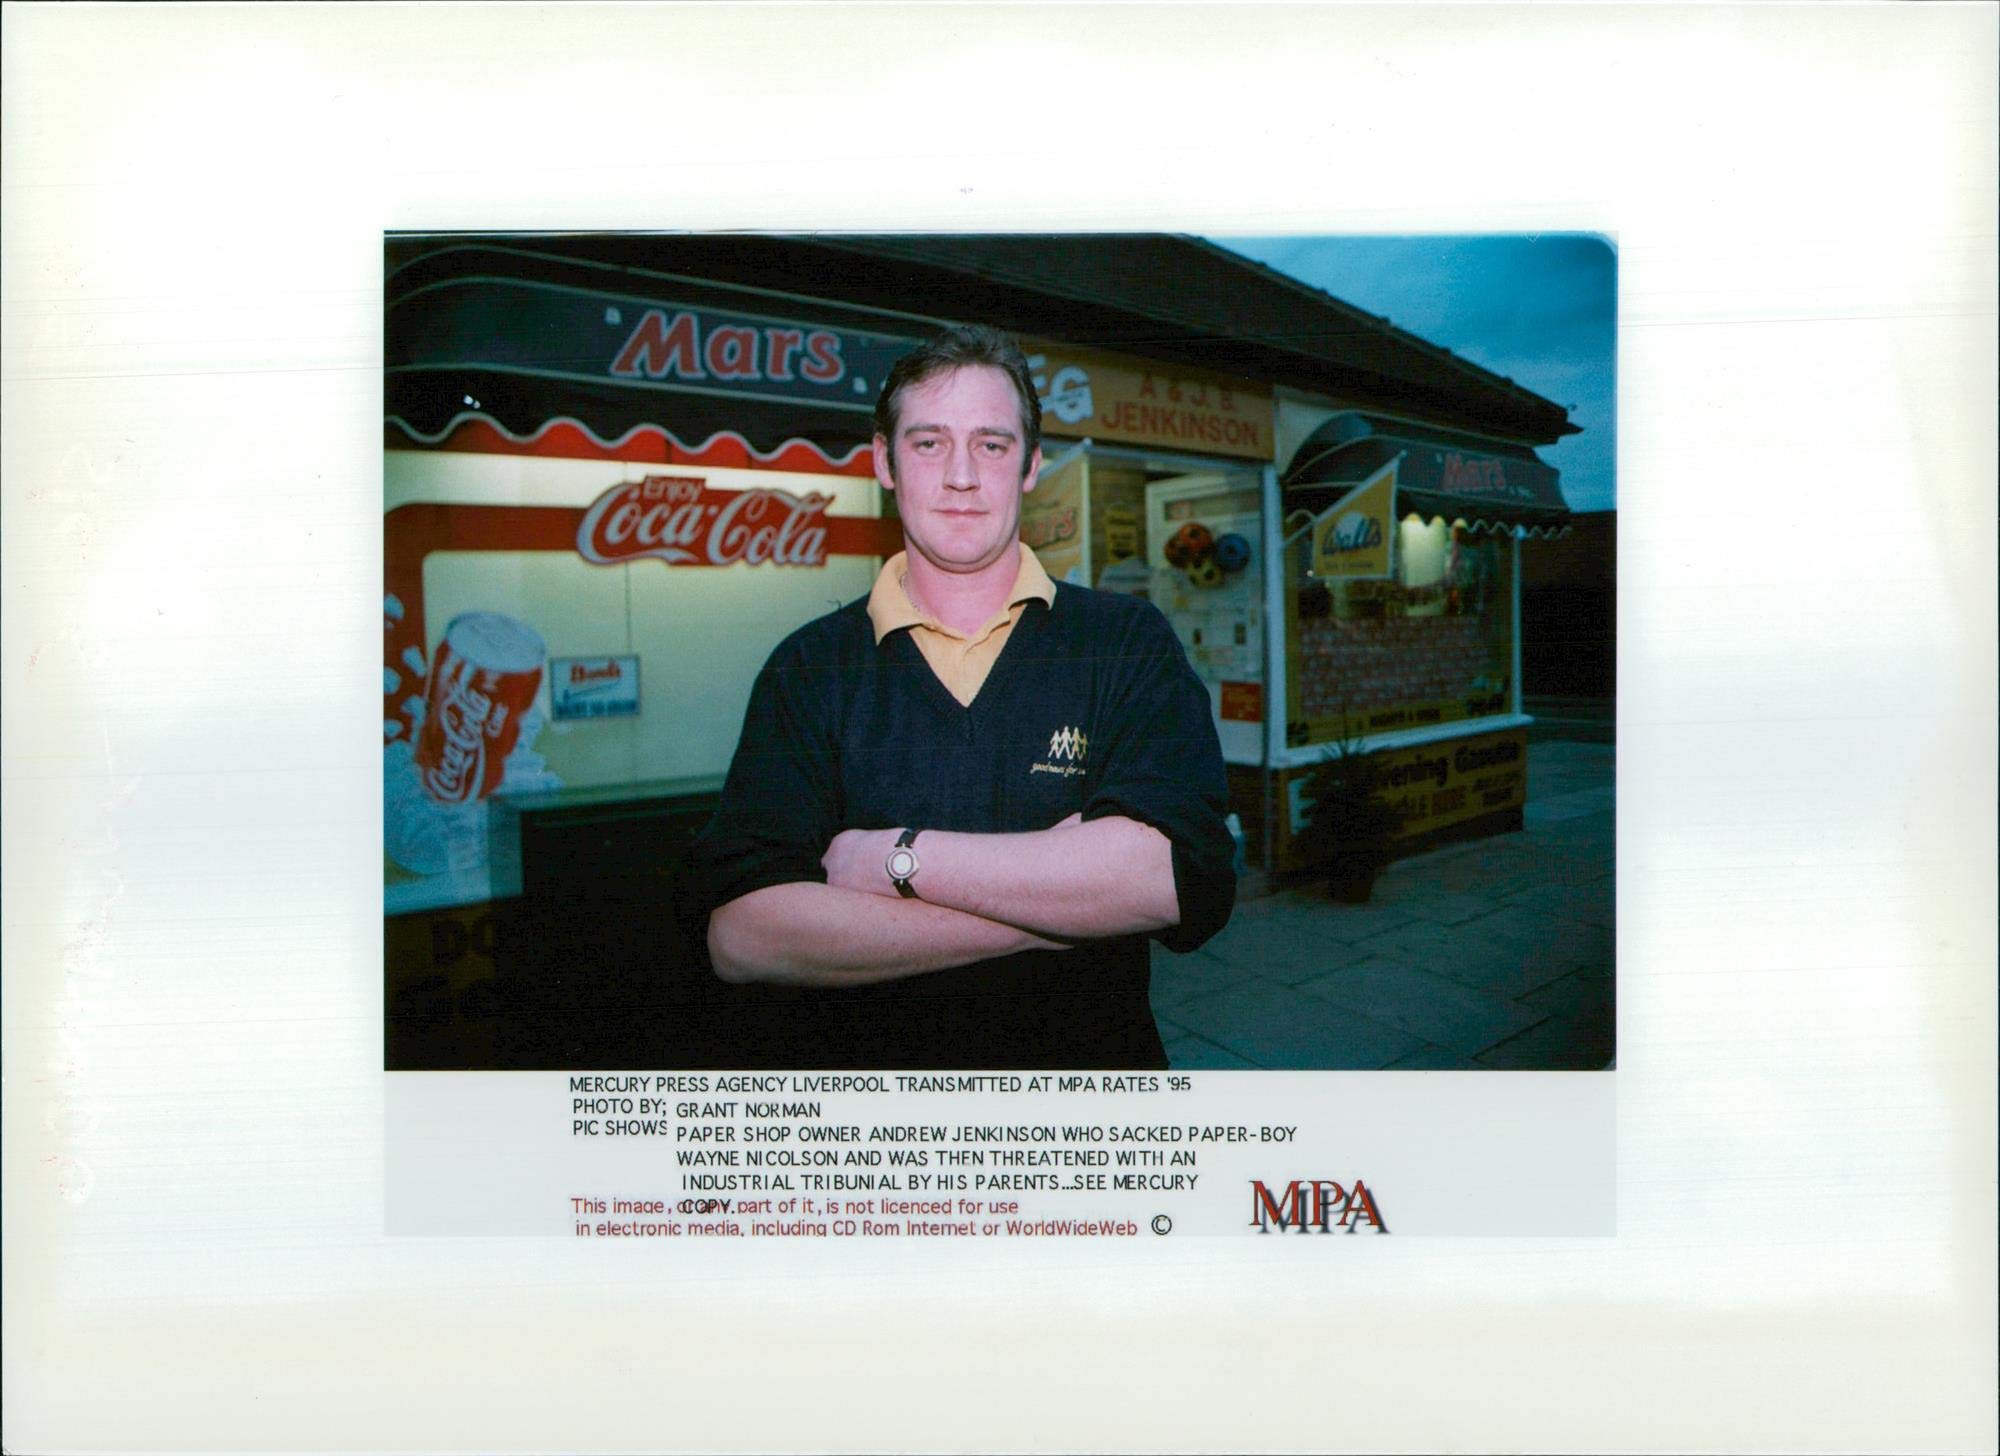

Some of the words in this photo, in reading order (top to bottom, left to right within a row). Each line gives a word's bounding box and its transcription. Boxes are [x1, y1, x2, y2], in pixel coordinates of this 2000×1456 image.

[609, 308, 846, 384] Mars
[1101, 400, 1260, 448] JENKINSON
[643, 477, 706, 504] Enjoy
[1442, 453, 1506, 492] Mars
[577, 486, 835, 566] Coca-Cola
